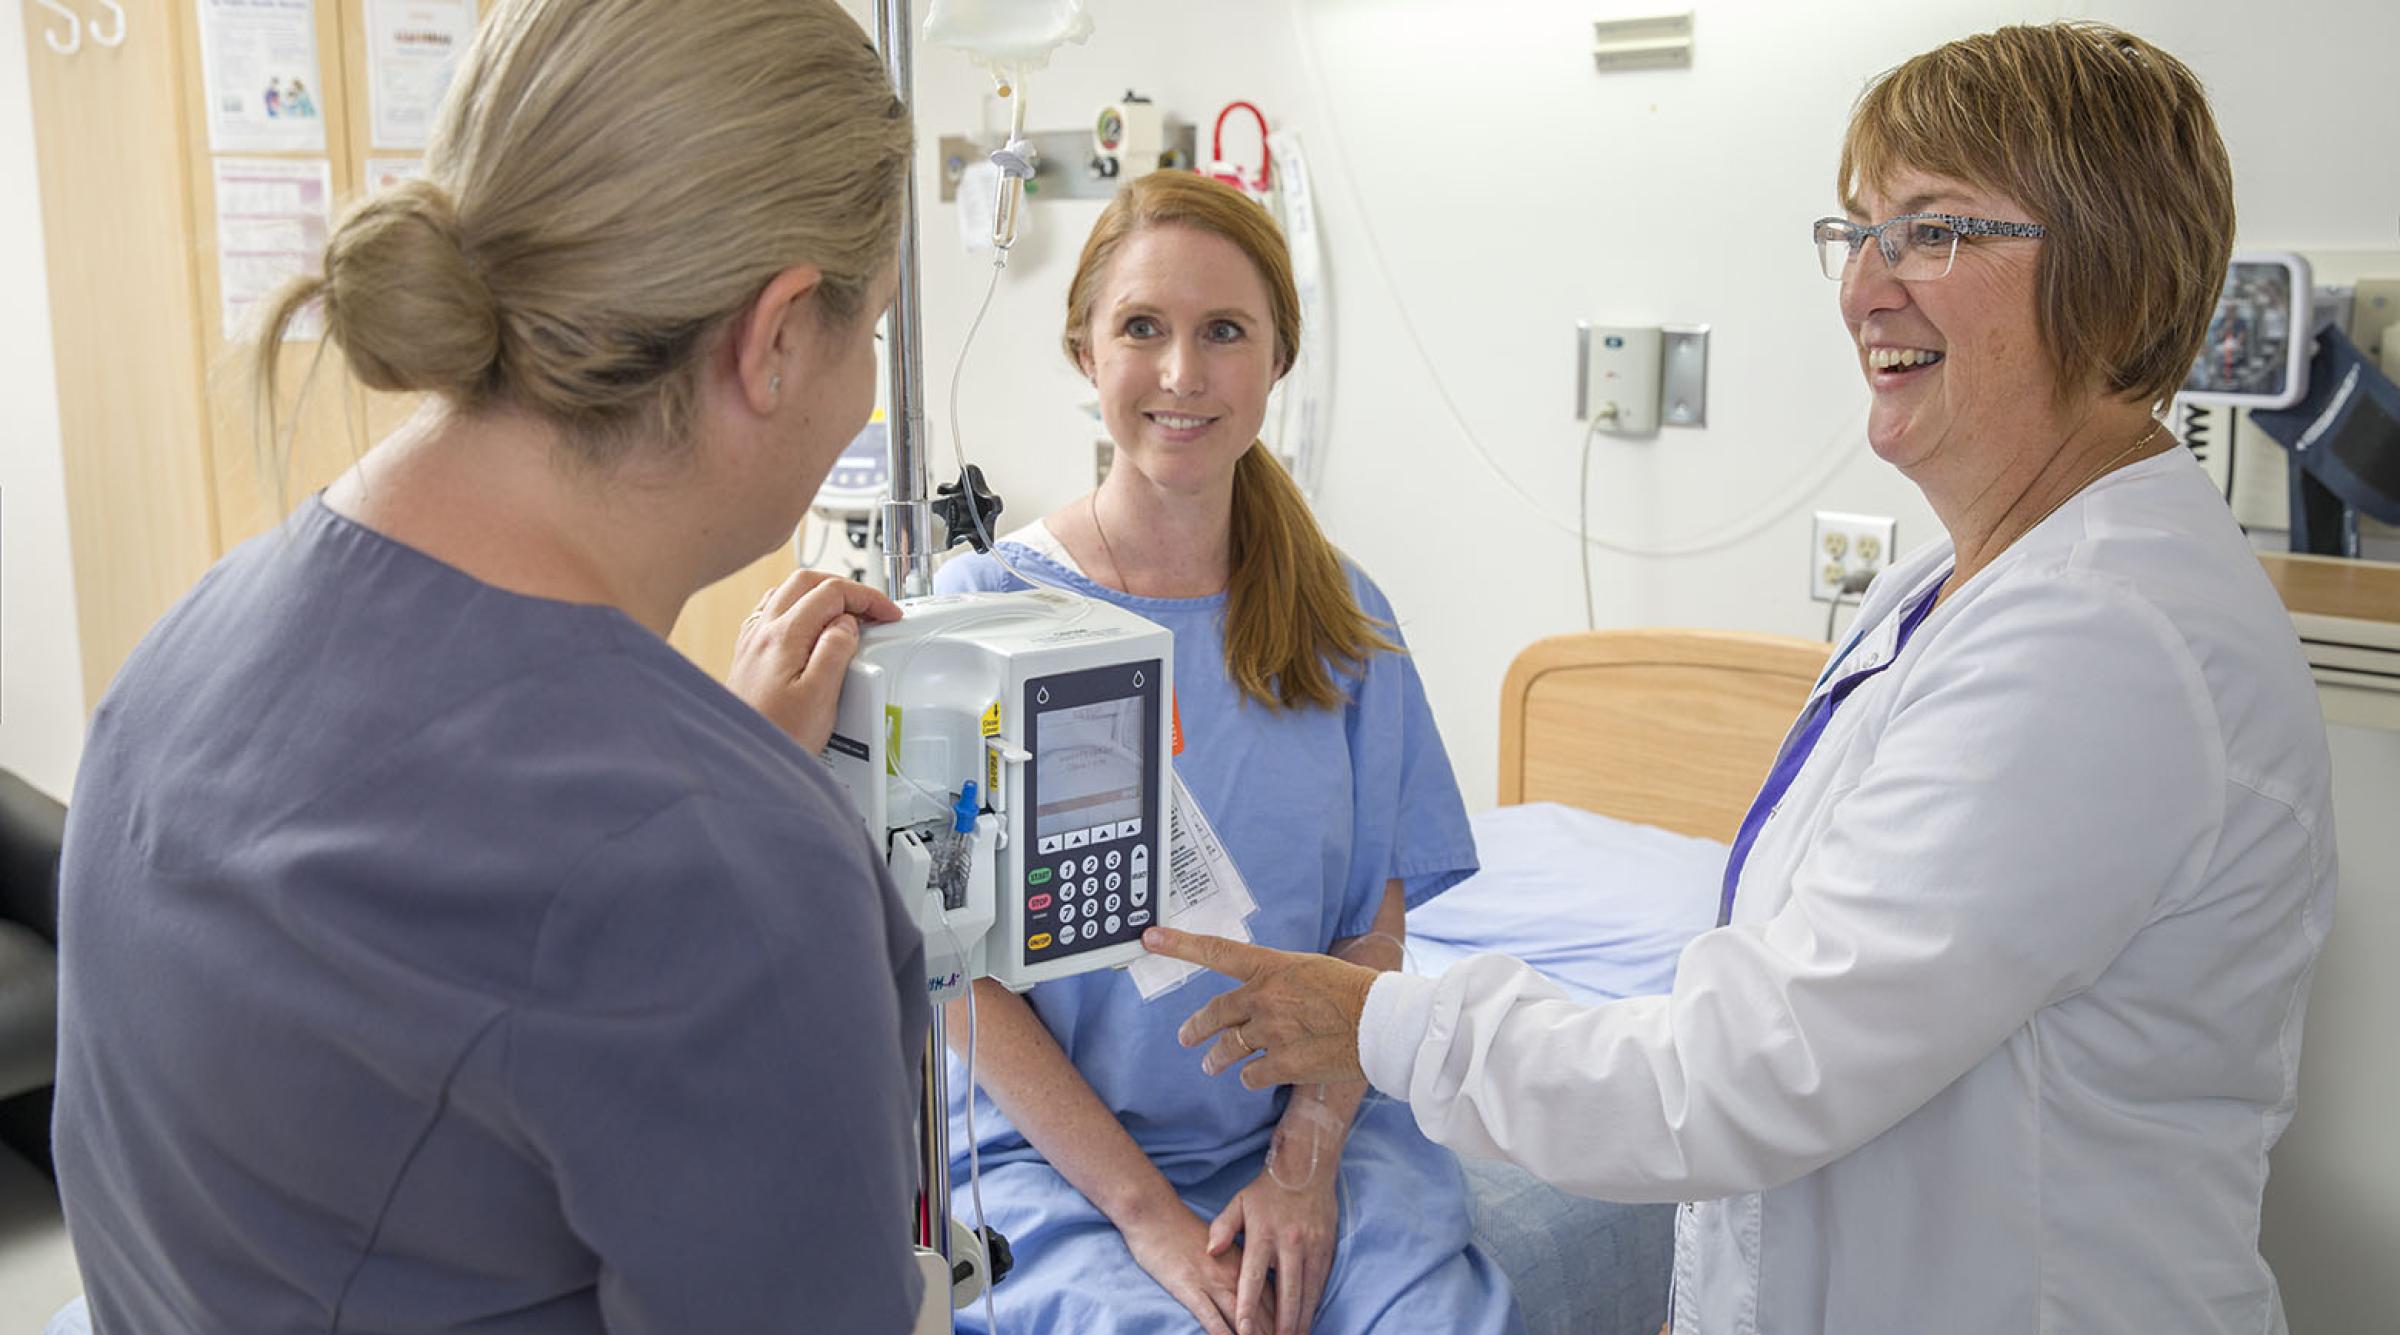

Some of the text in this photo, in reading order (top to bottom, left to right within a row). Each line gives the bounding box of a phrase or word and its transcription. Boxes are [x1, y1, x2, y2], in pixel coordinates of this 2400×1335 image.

[1087, 859, 1095, 871] 2
[1110, 854, 1118, 866] 3
[1065, 865, 1071, 876] 1
[1031, 871, 1050, 882] START
[1109, 876, 1117, 887] 6
[1064, 886, 1072, 897] 4
[1086, 881, 1095, 893] 5
[1032, 897, 1049, 907] STOP
[1109, 897, 1117, 909] 9
[1063, 908, 1072, 920] 7
[1086, 903, 1095, 914] 8
[1087, 924, 1094, 935] 0
